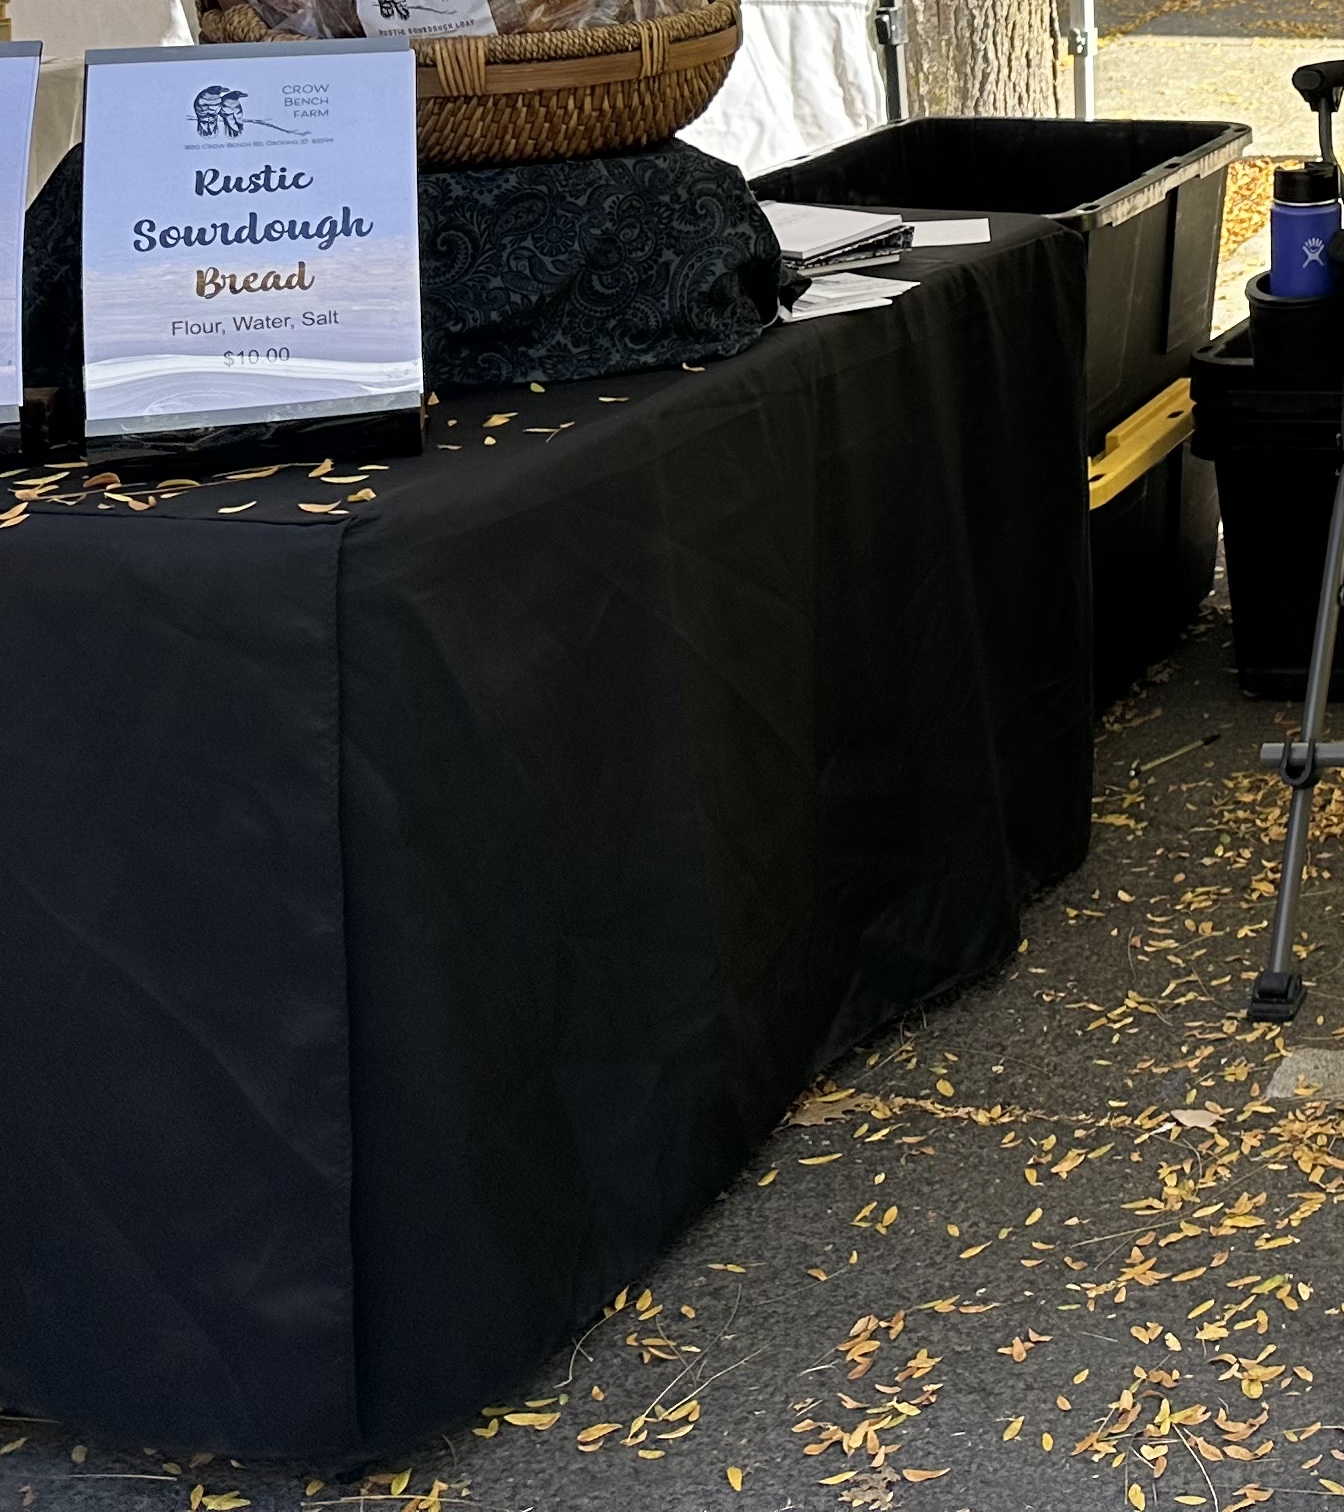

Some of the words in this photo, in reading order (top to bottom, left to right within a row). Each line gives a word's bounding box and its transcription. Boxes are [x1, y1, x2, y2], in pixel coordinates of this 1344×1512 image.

[282, 84, 329, 94] CROW
[284, 97, 329, 106] BENCH
[294, 109, 329, 118] FARM
[194, 164, 314, 196] Rustic
[133, 206, 375, 253] Sourdough
[195, 260, 315, 299] Bread
[172, 320, 226, 336] Flour,
[232, 315, 295, 331] Water,
[301, 310, 339, 326] Salt
[223, 347, 290, 368] $10.00
